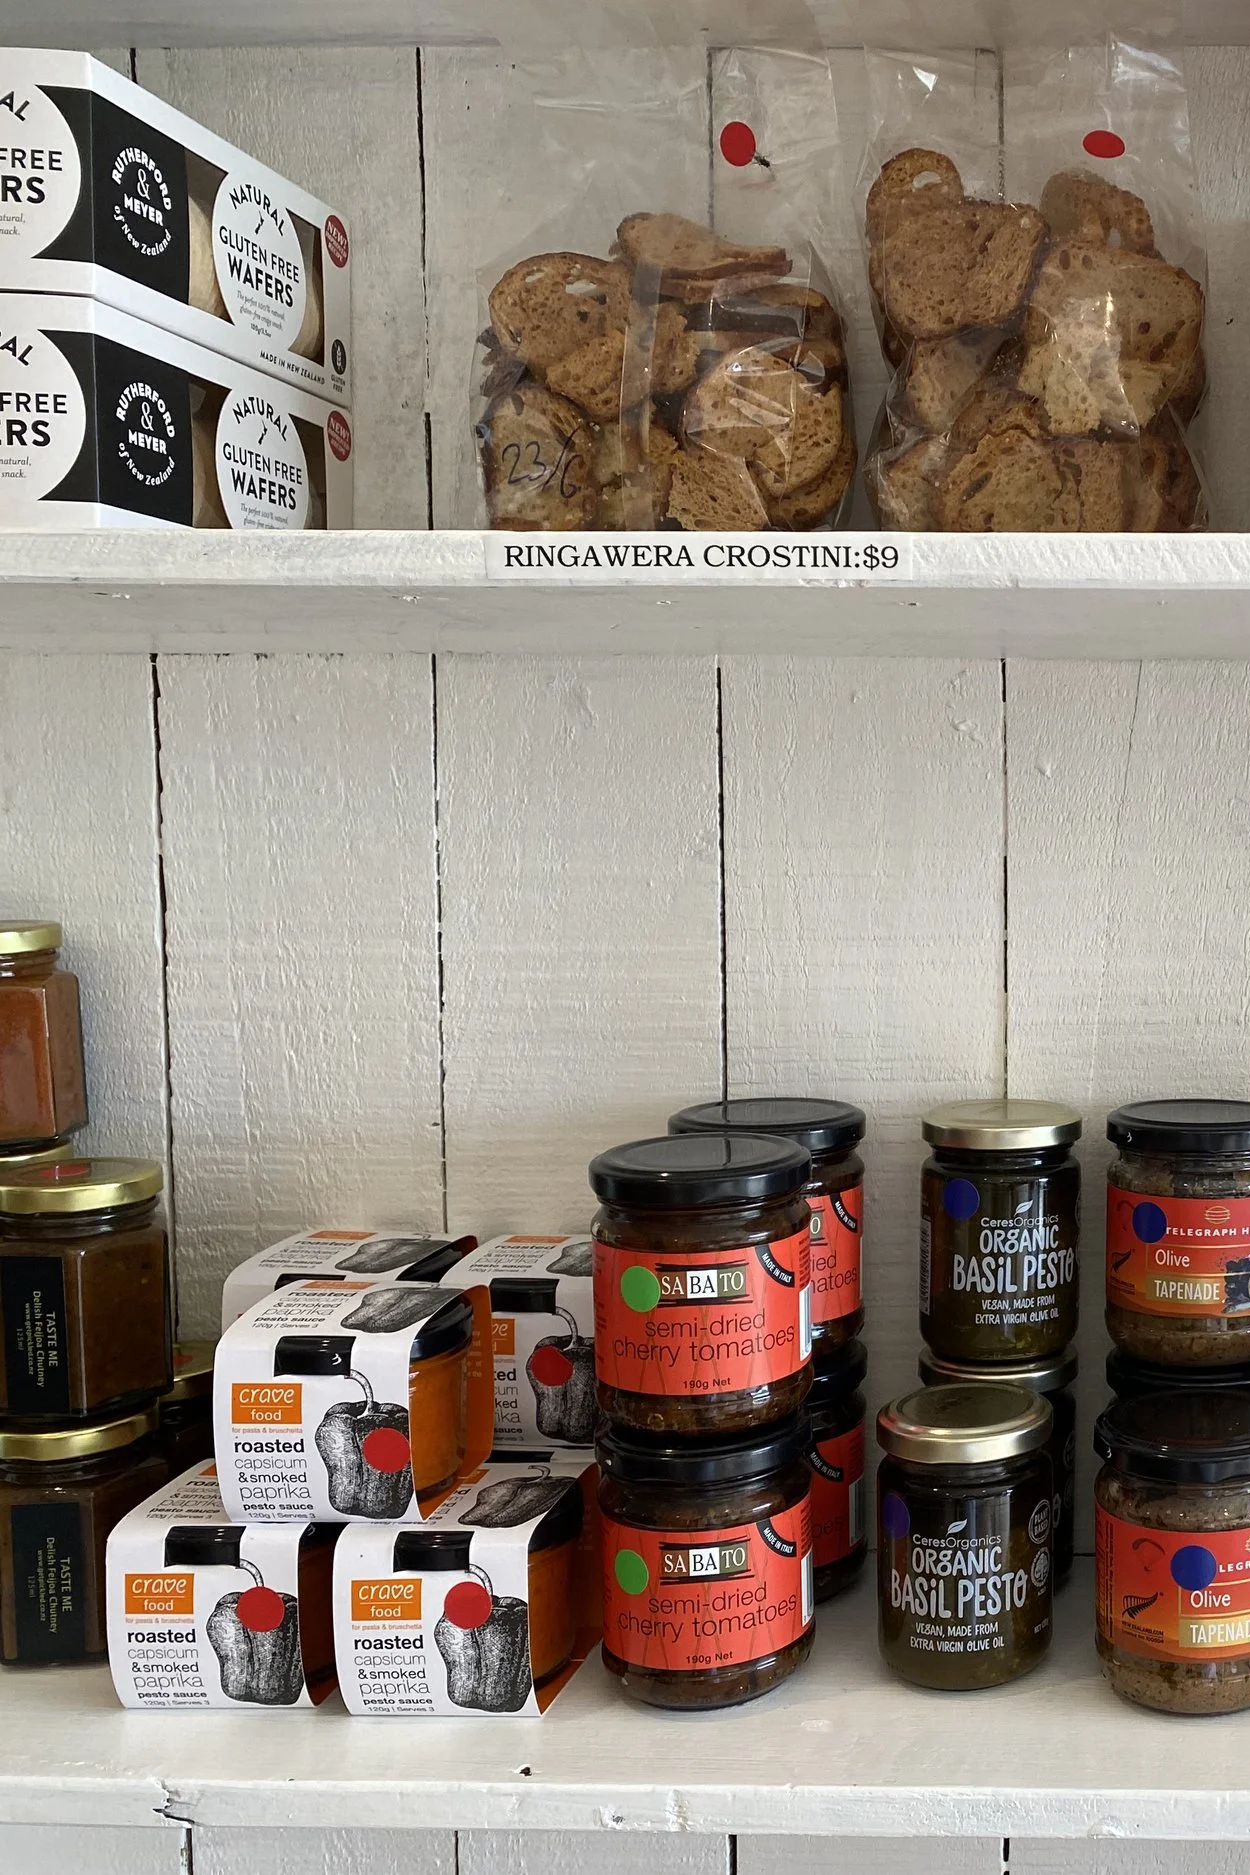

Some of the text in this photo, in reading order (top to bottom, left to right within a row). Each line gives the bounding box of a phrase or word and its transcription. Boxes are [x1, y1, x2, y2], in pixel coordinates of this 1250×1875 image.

[112, 148, 171, 211] RUTHERFORD
[124, 194, 163, 226] MEYER
[229, 184, 285, 236] NATURAL
[114, 206, 172, 255] of New Zealand
[220, 226, 299, 283] GLUTEN FREE
[228, 253, 293, 307] WAFERS
[260, 351, 325, 384] MADE IN NEW ZEALAND
[116, 383, 175, 438] RUTHERFORD
[233, 397, 289, 441] NATURAL
[129, 430, 167, 455] MEYER
[223, 443, 302, 485] GLUTEN FREE
[232, 468, 296, 510] WAFERS
[504, 544, 899, 571] RINGAWERA CROSTINI:$9
[1165, 1225, 1237, 1237] TELEGRAPH
[1155, 1249, 1190, 1268] Olive
[33, 1291, 44, 1319] Delish
[1154, 1280, 1219, 1301] TAPENADE
[645, 1308, 765, 1337] semi-dried
[46, 1311, 58, 1367] TASTE ME
[614, 1325, 795, 1367] cherry tomatoes
[36, 1350, 44, 1387] Chutney
[683, 1378, 730, 1390] 190g Net
[251, 1409, 281, 1421] food
[234, 1439, 304, 1453] roasted
[235, 1456, 307, 1471] capsicum
[240, 1483, 312, 1501] paprika
[243, 1503, 275, 1511] pesto
[958, 1569, 1027, 1618] PESTO
[948, 1625, 971, 1636] MADE
[975, 1622, 998, 1635] FROM
[910, 1637, 934, 1651] EXTRA
[937, 1641, 963, 1652] VIRGIN
[967, 1639, 989, 1652] OLIVE
